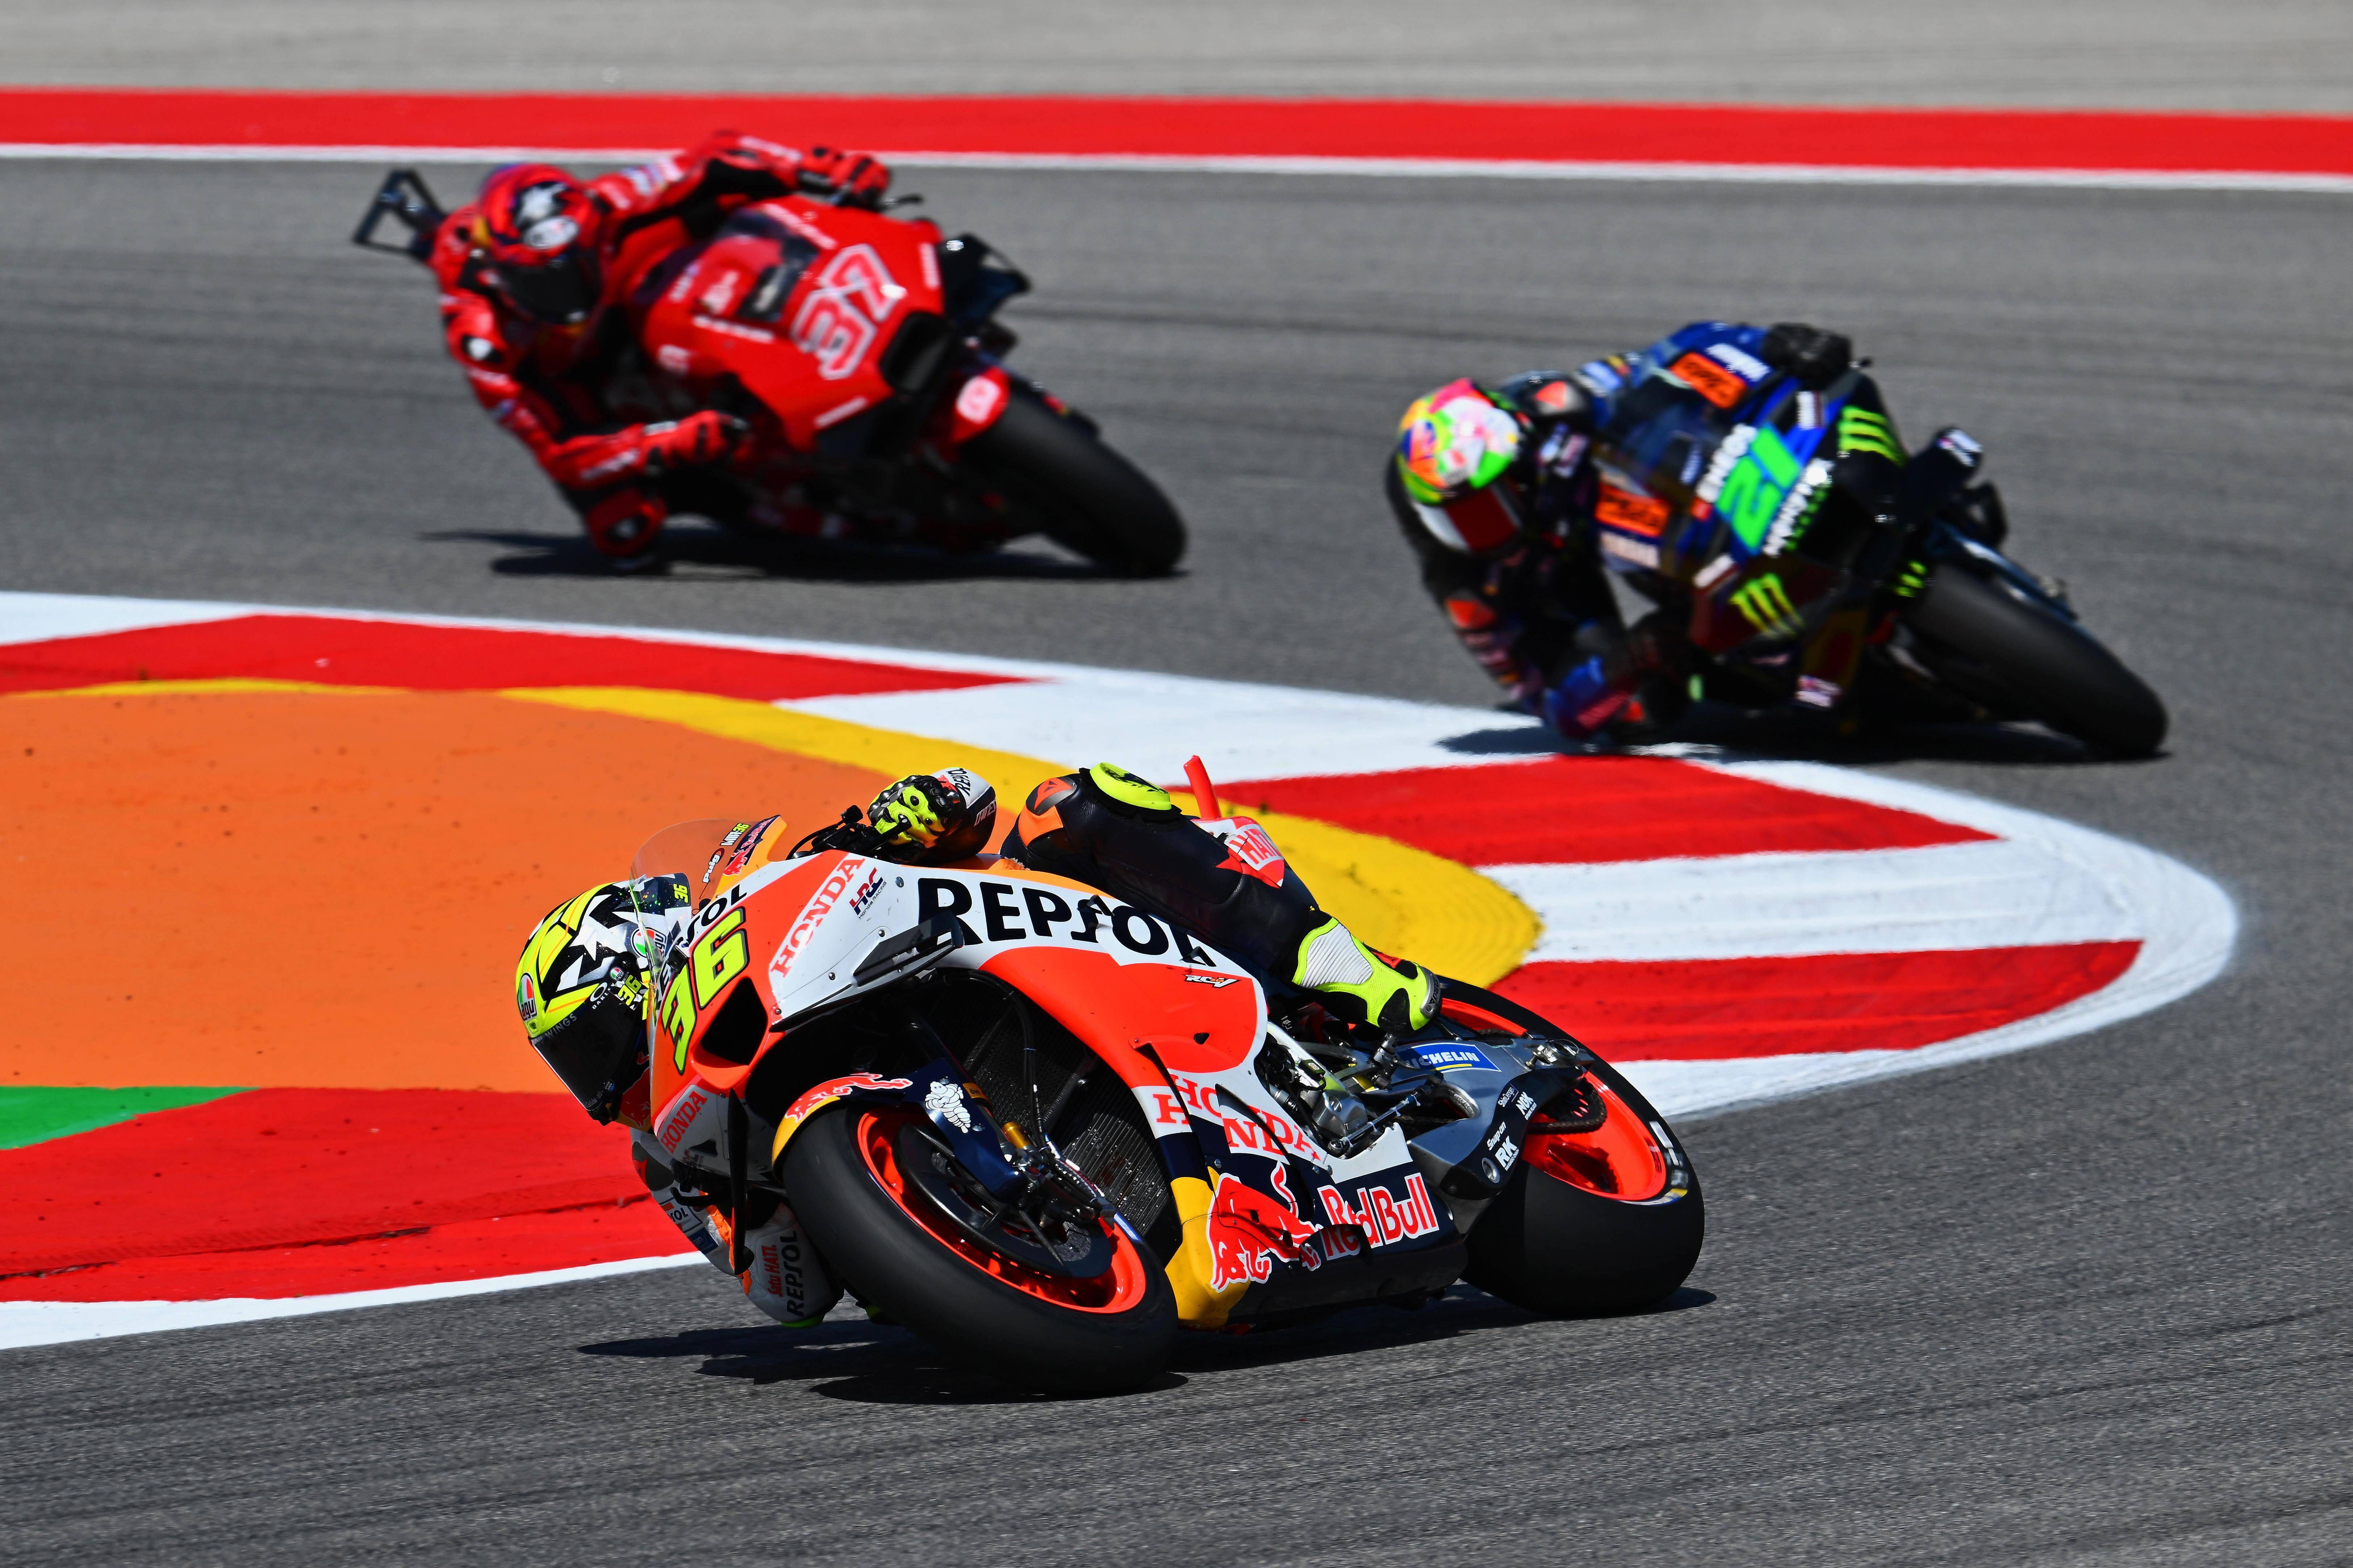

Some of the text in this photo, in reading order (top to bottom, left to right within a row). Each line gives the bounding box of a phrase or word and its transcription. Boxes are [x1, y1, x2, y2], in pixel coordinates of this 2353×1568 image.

[791, 243, 900, 380] 37
[1716, 427, 1801, 548] 21
[703, 854, 720, 883] Puig
[673, 884, 688, 903] 36
[849, 867, 883, 916] HRC
[858, 881, 887, 919] Honda RACING
[770, 858, 865, 978] HONDA
[918, 878, 1217, 967] REPSOL
[617, 975, 641, 1006] 36
[661, 906, 749, 1075] 36
[545, 1013, 577, 1039] WINGS
[1407, 1051, 1480, 1069] ICHELIN
[661, 1090, 708, 1154] HONDA
[1516, 1091, 1534, 1116] NGK
[1487, 1121, 1506, 1151] Snap-on
[1495, 1135, 1518, 1168] RK
[1317, 1172, 1439, 1261] Red Bull
[780, 1230, 804, 1317] REPSOL
